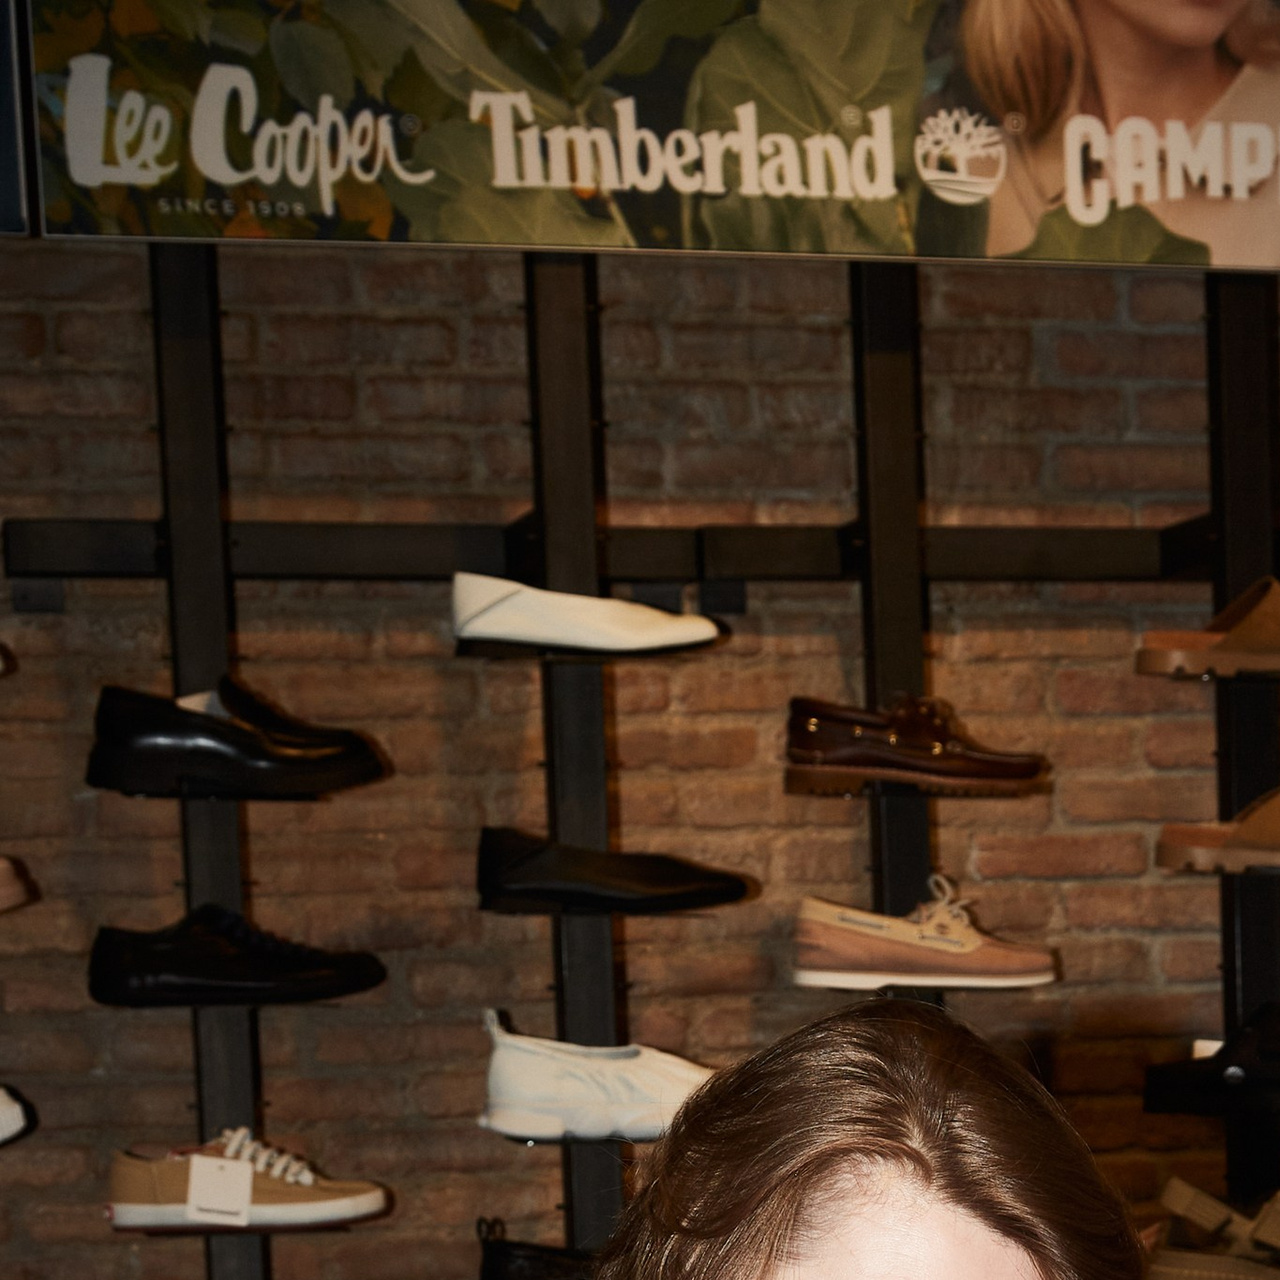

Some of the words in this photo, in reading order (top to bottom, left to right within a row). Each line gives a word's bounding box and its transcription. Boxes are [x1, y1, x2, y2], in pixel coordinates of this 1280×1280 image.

[64, 53, 179, 187] Lee
[190, 63, 435, 218] Cooper
[469, 90, 899, 200] Timberland
[157, 199, 235, 215] SINCE
